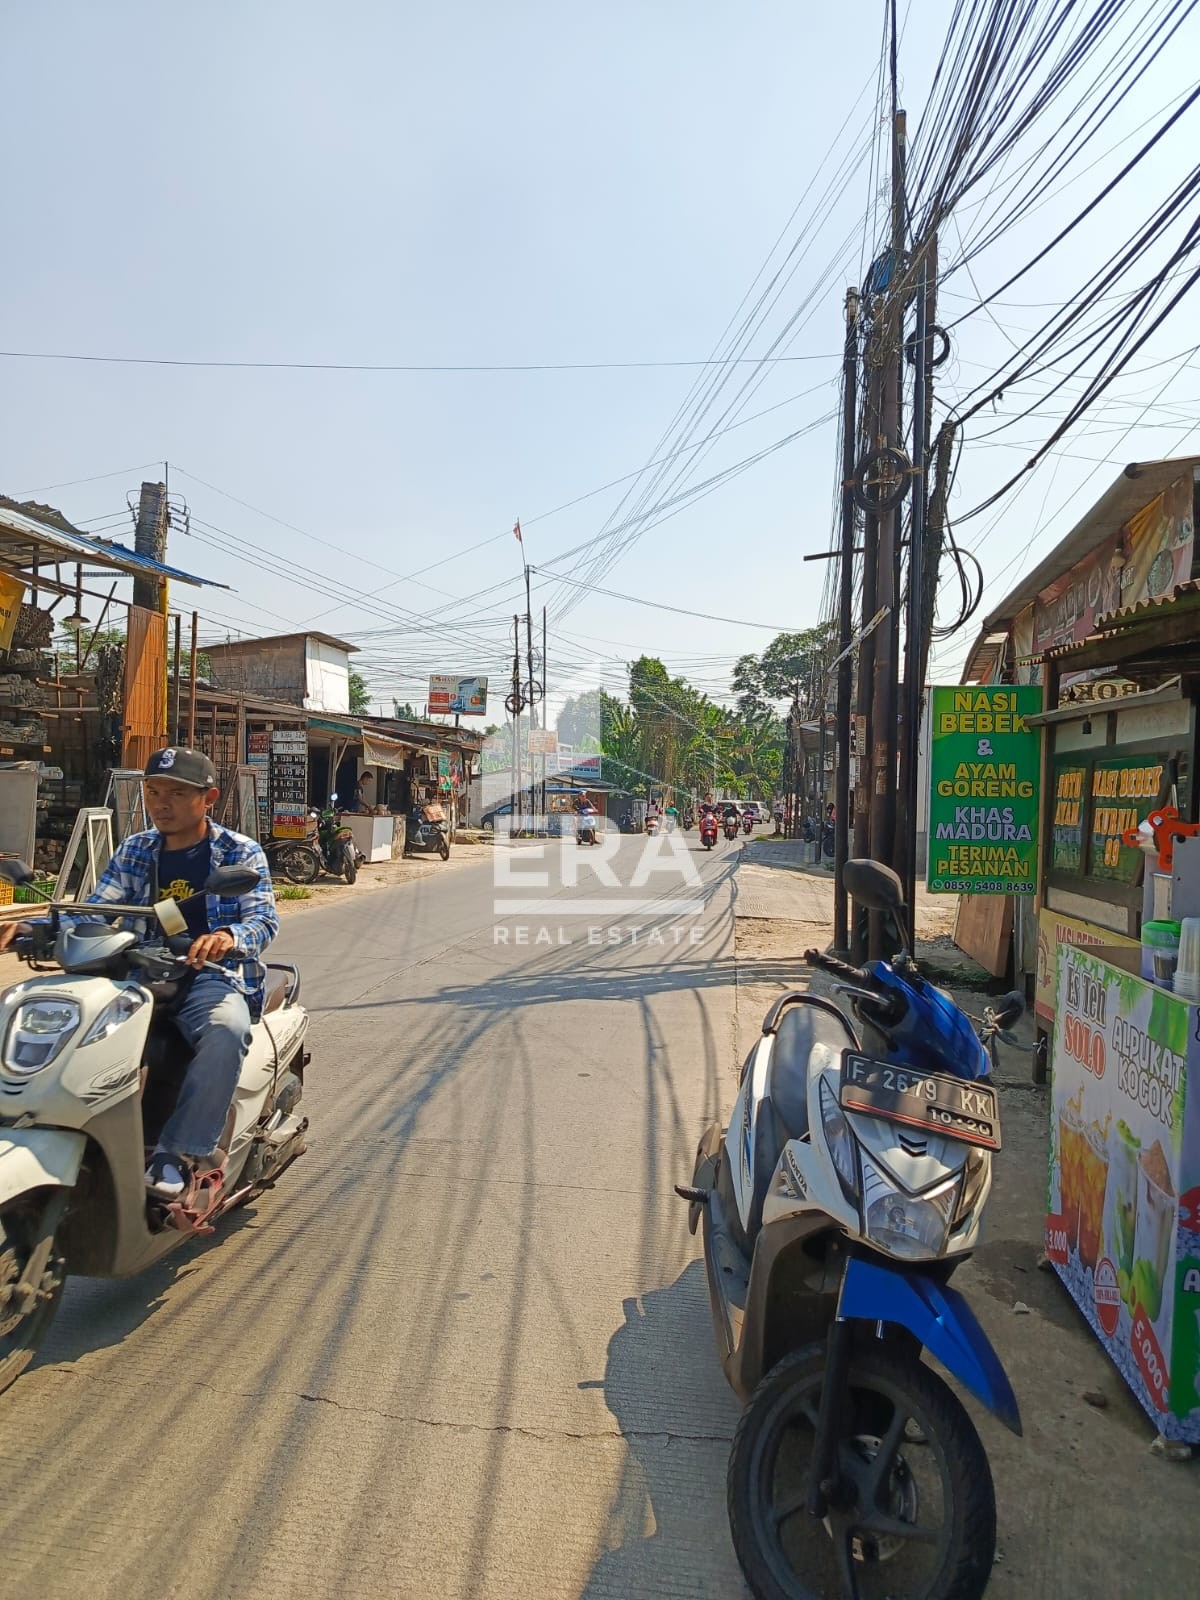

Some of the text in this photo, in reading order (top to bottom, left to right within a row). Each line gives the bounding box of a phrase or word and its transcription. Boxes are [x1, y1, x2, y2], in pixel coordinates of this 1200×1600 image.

[954, 692, 1017, 712] NASI
[940, 713, 1032, 734] BEBEK
[976, 739, 994, 756] &
[158, 749, 176, 769] S
[954, 763, 1016, 780] AYAM
[1092, 765, 1163, 797] NASI BEBEK
[937, 781, 1033, 798] GORENG
[1057, 772, 1082, 798] SOTO
[955, 807, 1014, 824] KHAS
[1055, 801, 1080, 826] AYAM
[936, 823, 1032, 841] MADURA
[948, 846, 1018, 861] TERIMA
[937, 860, 1029, 877] PESANAN
[944, 881, 1034, 892] 0859 5408 8639
[1082, 973, 1107, 1029] Teh
[1063, 1011, 1106, 1080] SOLO
[1112, 1016, 1185, 1093] ALPUKAT
[882, 1070, 938, 1102] 2679
[960, 1089, 991, 1117] KK
[786, 1149, 808, 1193] HONDA
[1048, 1229, 1067, 1252] 3.000
[1133, 1318, 1163, 1391] 5.000
